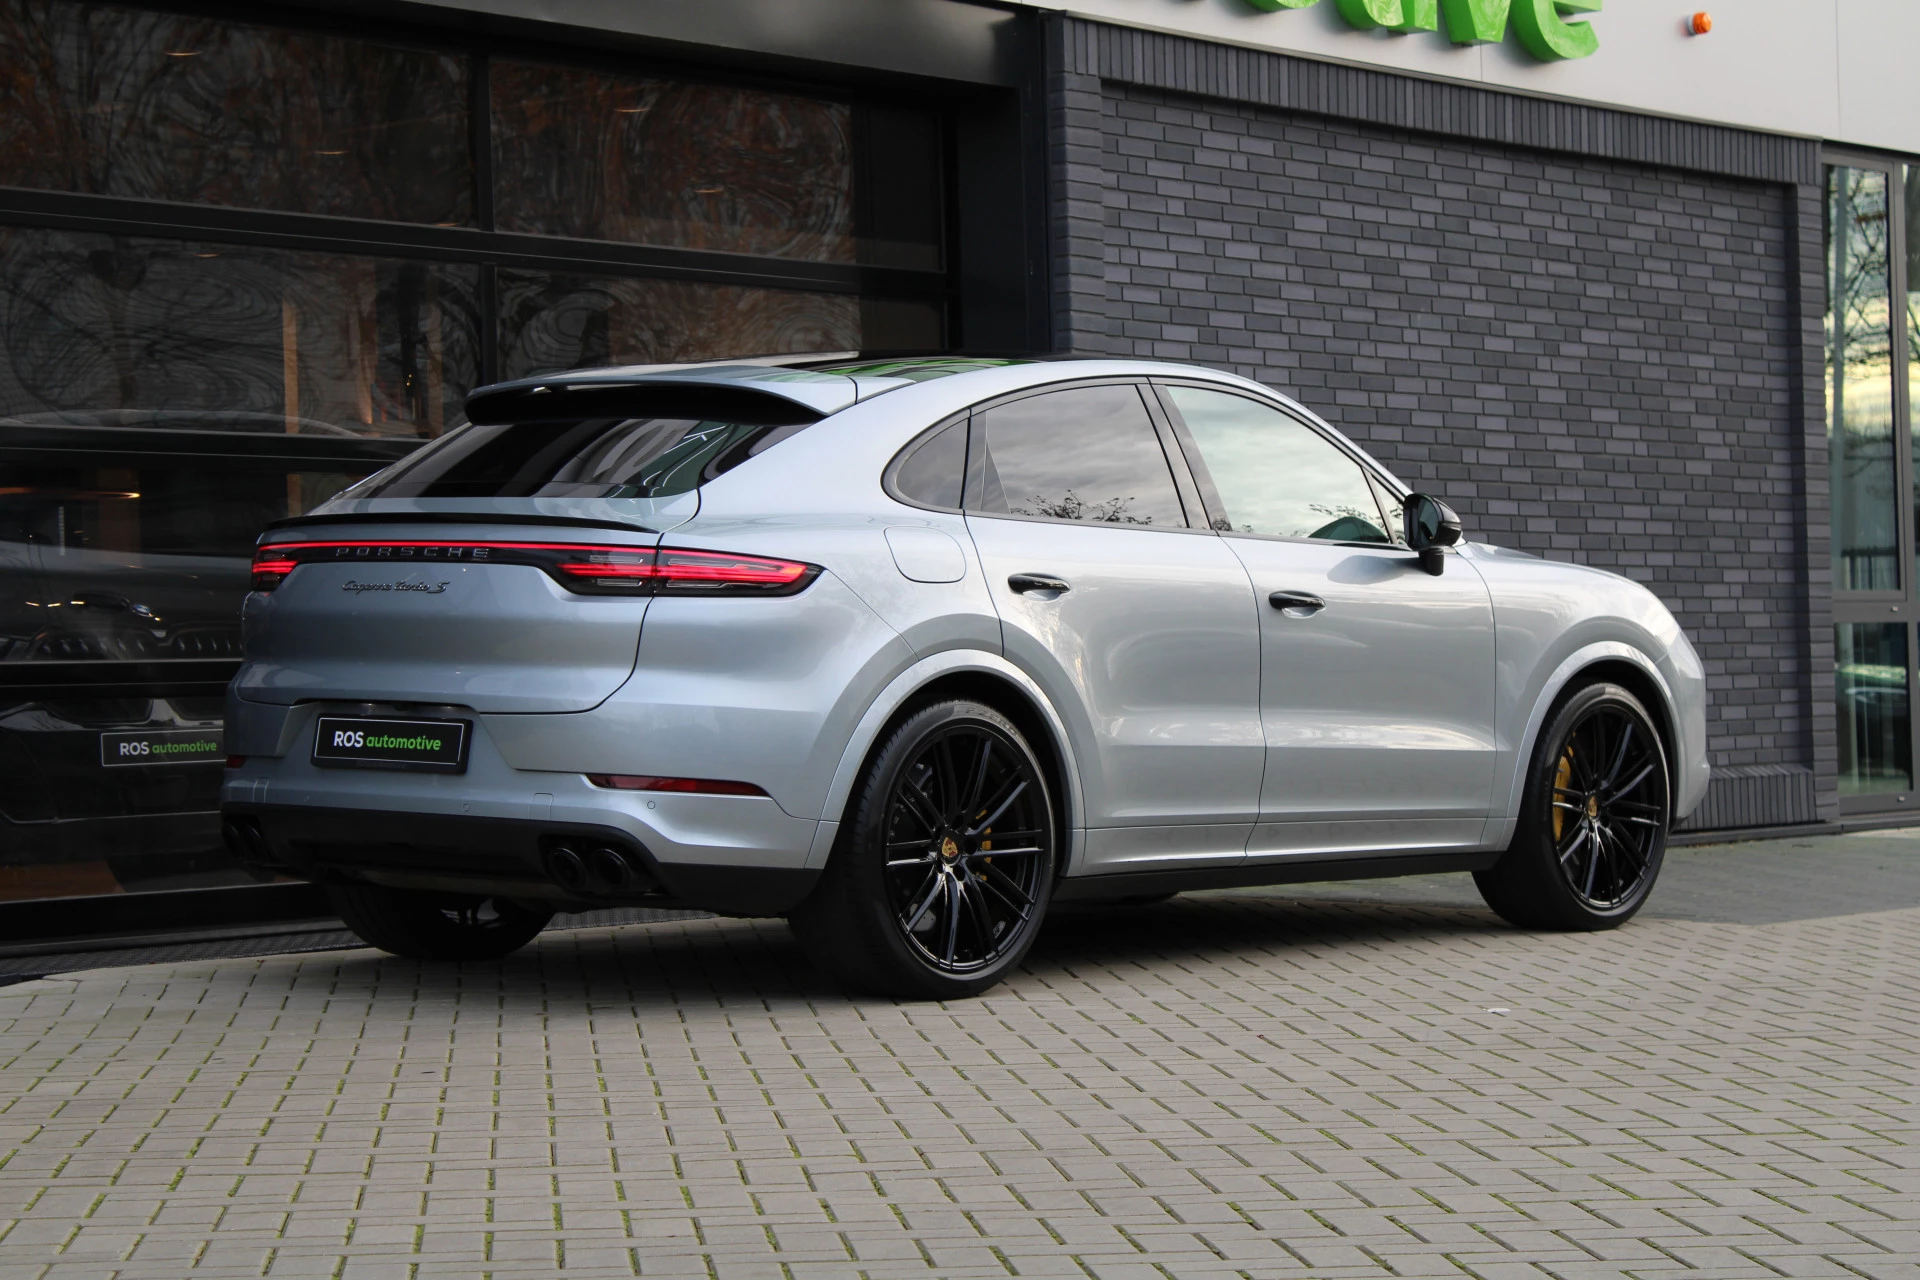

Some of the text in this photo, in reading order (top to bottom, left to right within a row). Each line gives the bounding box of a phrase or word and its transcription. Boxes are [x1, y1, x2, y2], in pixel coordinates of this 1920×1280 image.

[337, 547, 489, 558] PORSCHE
[120, 740, 217, 755] ROS automotive
[333, 731, 441, 750] ROS automotive
